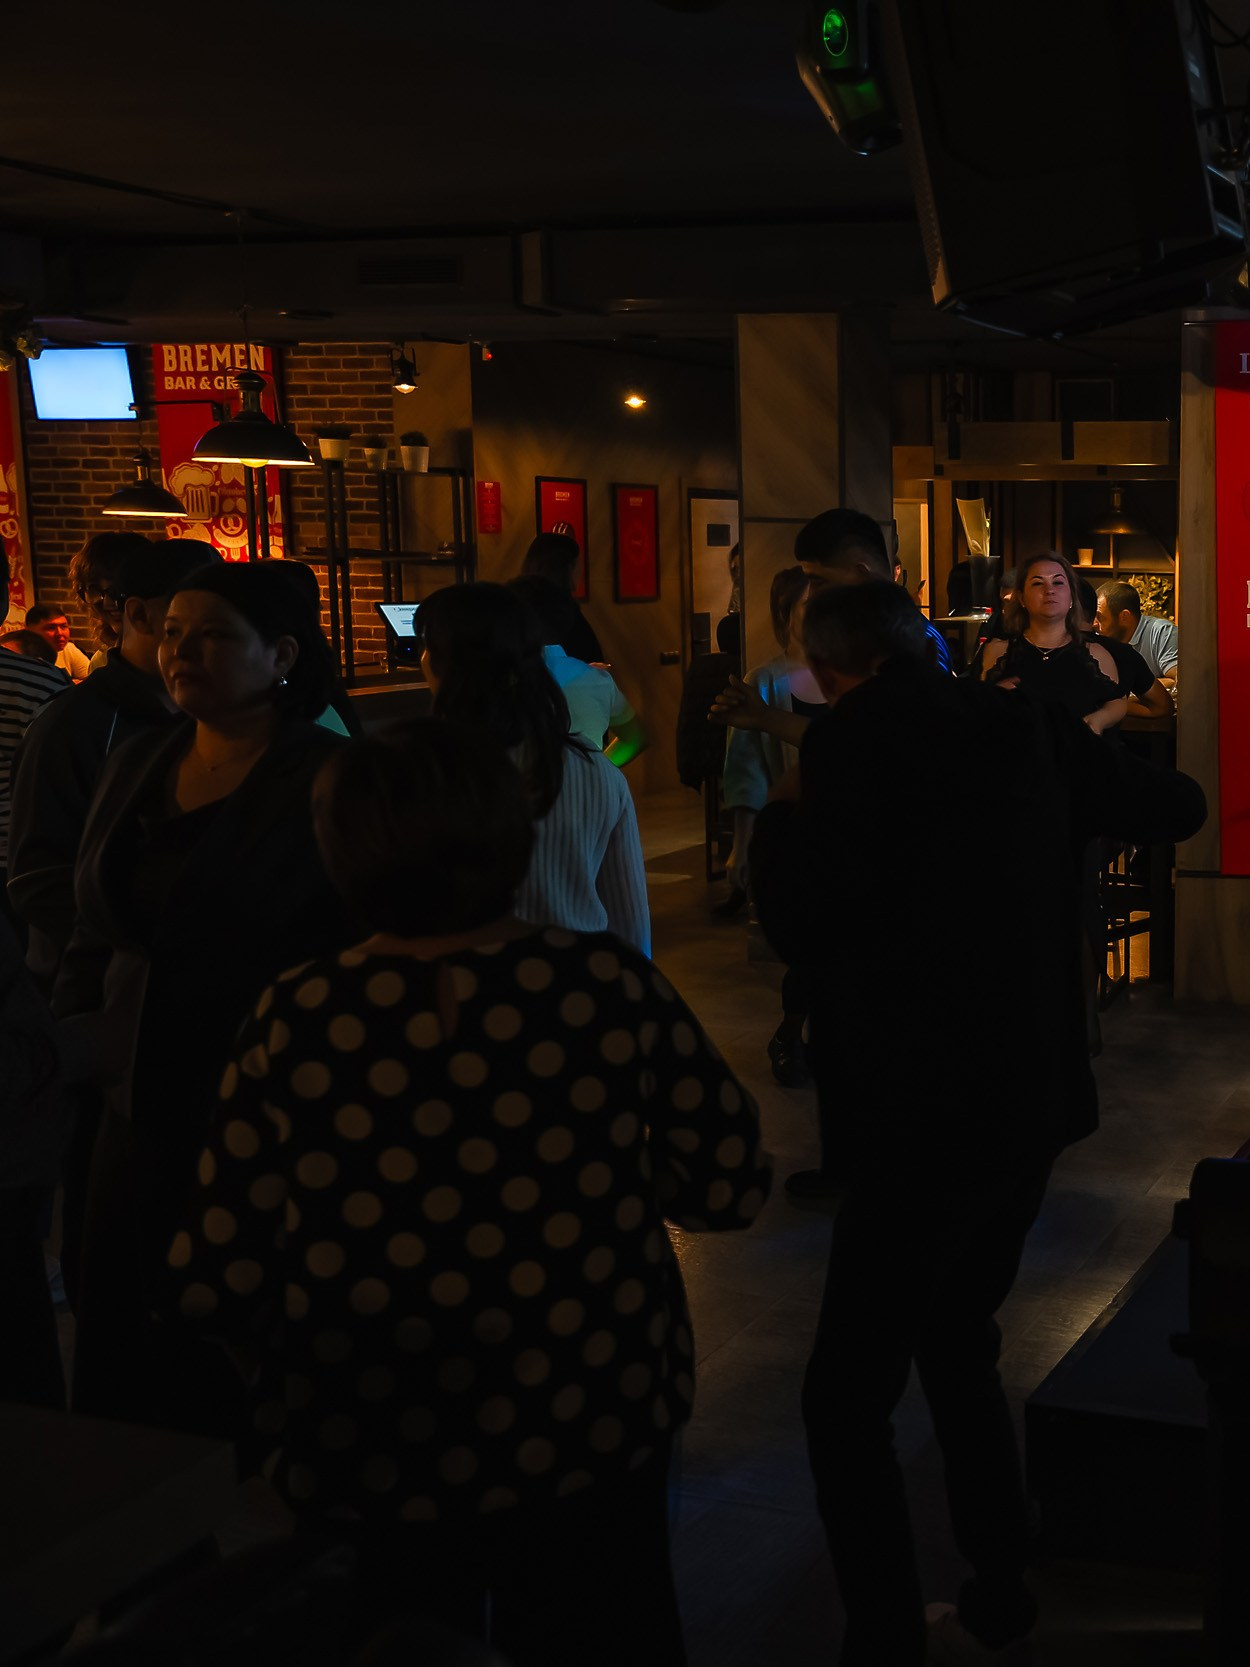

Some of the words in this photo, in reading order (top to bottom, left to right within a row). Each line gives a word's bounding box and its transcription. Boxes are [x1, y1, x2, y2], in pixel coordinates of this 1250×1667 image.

[162, 344, 265, 372] BREMEN
[164, 376, 196, 390] BAR
[199, 376, 212, 390] &
